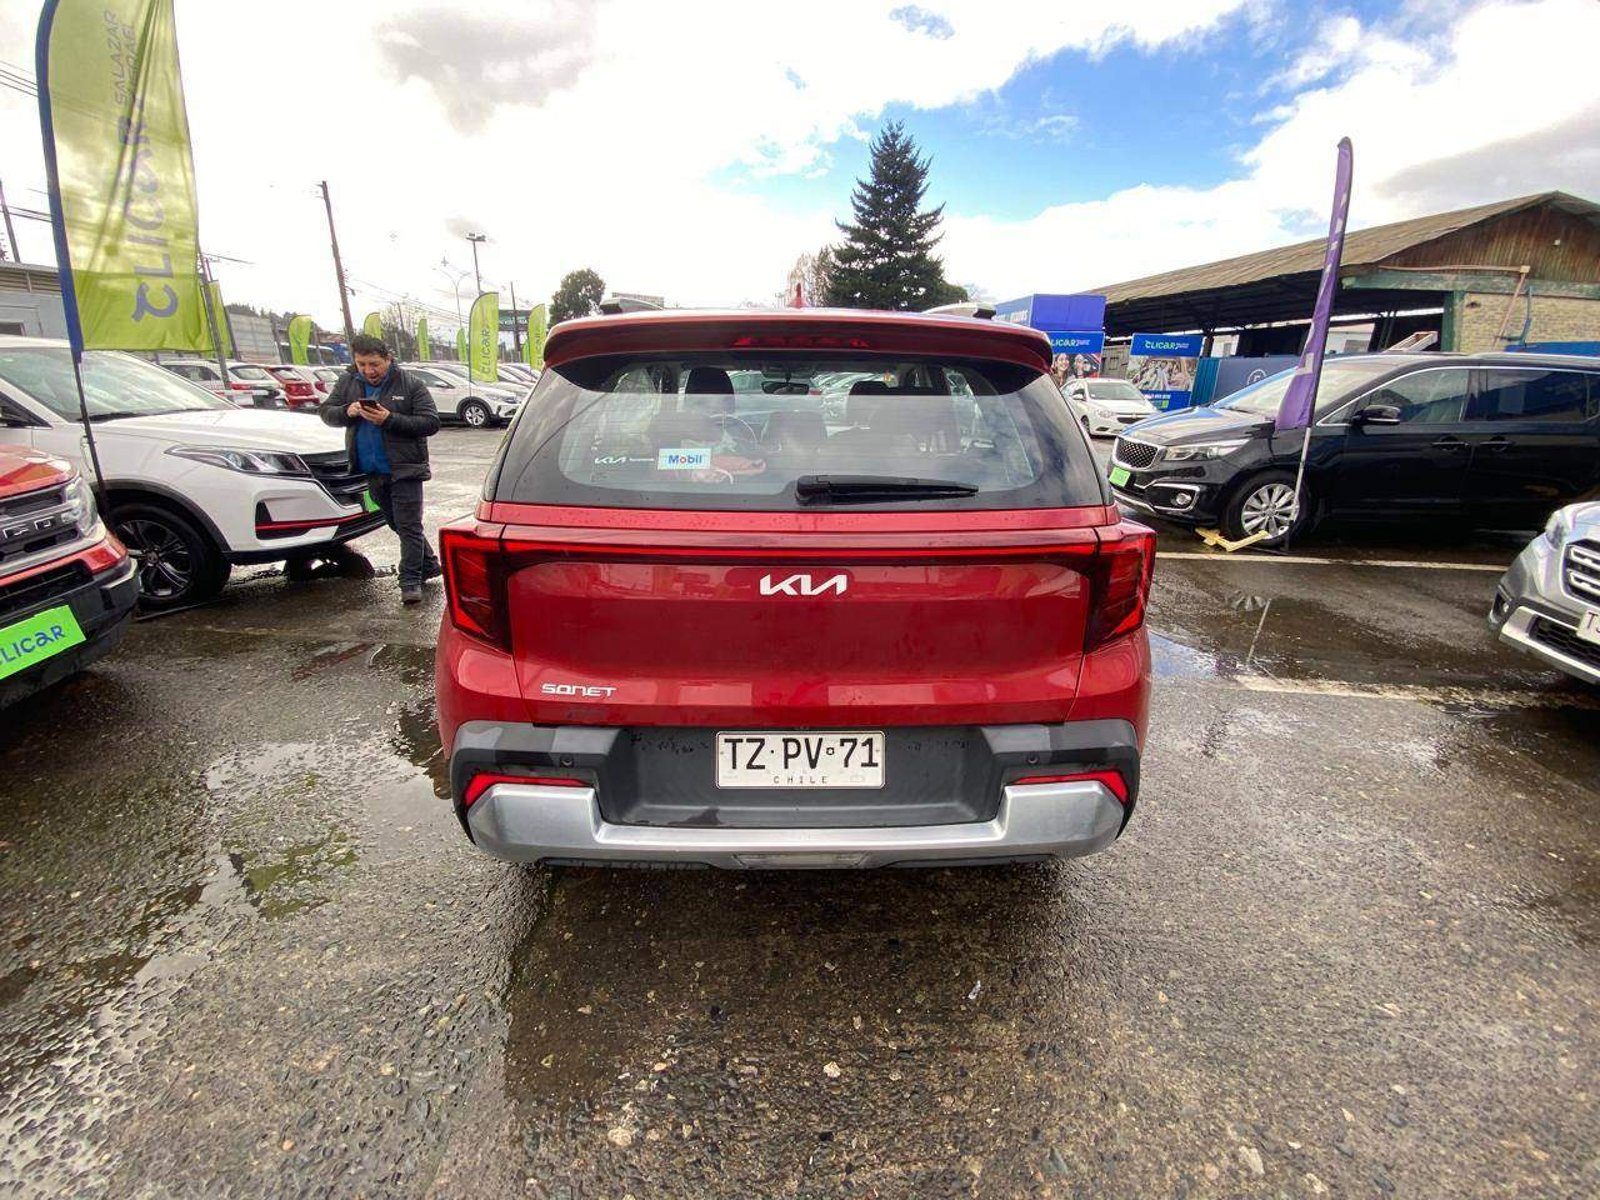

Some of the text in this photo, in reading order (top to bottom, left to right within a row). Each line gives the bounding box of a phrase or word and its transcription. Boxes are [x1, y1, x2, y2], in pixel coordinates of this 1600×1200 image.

[104, 8, 126, 105] SALAZAR
[668, 454, 702, 465] Mobil
[759, 574, 848, 596] KIA
[0, 624, 65, 665] LICaR
[541, 683, 617, 697] SONET
[773, 775, 829, 784] CHILE
